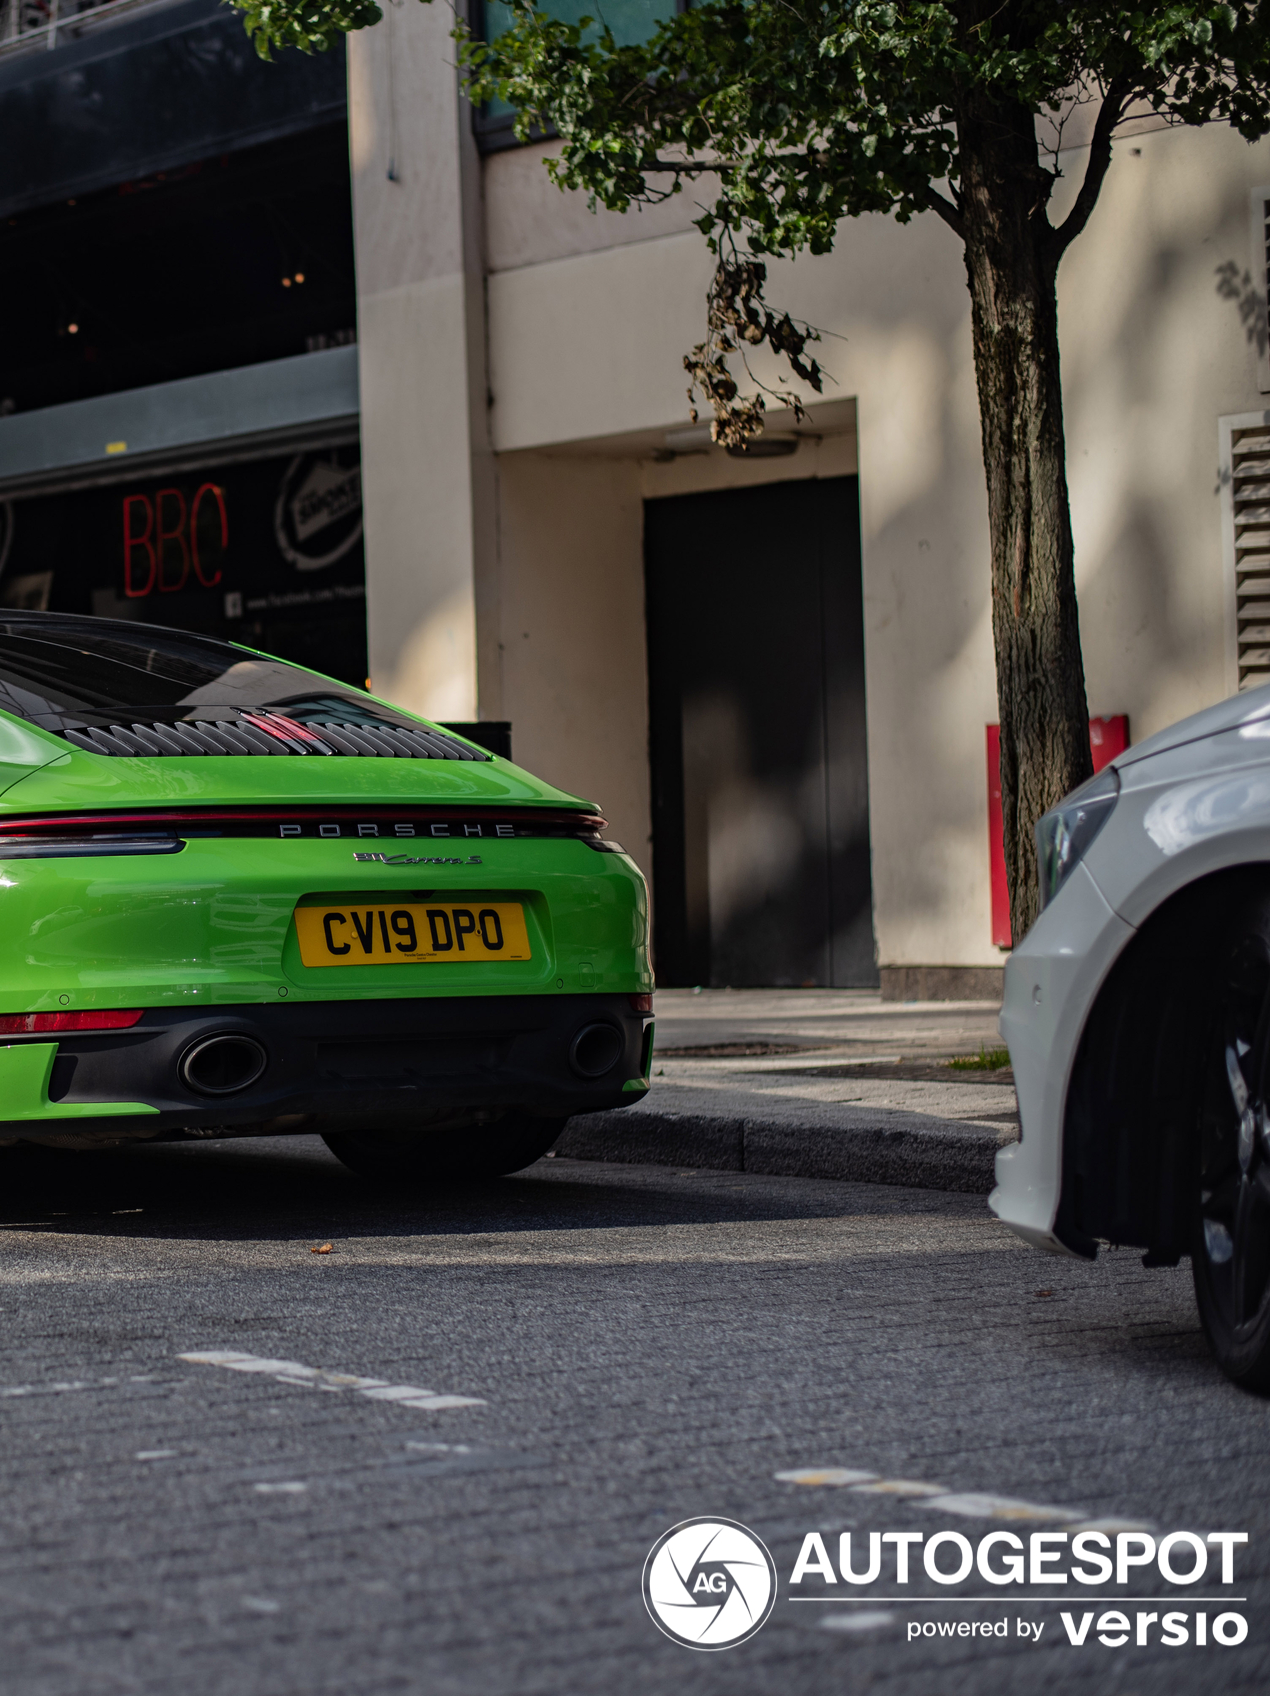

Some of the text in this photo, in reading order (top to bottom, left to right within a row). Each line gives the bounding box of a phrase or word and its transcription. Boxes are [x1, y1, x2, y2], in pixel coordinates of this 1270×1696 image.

[279, 823, 517, 838] PORSCHE
[383, 854, 463, 864] Carrera
[465, 855, 483, 864] S
[323, 909, 504, 955] CV19 DPO
